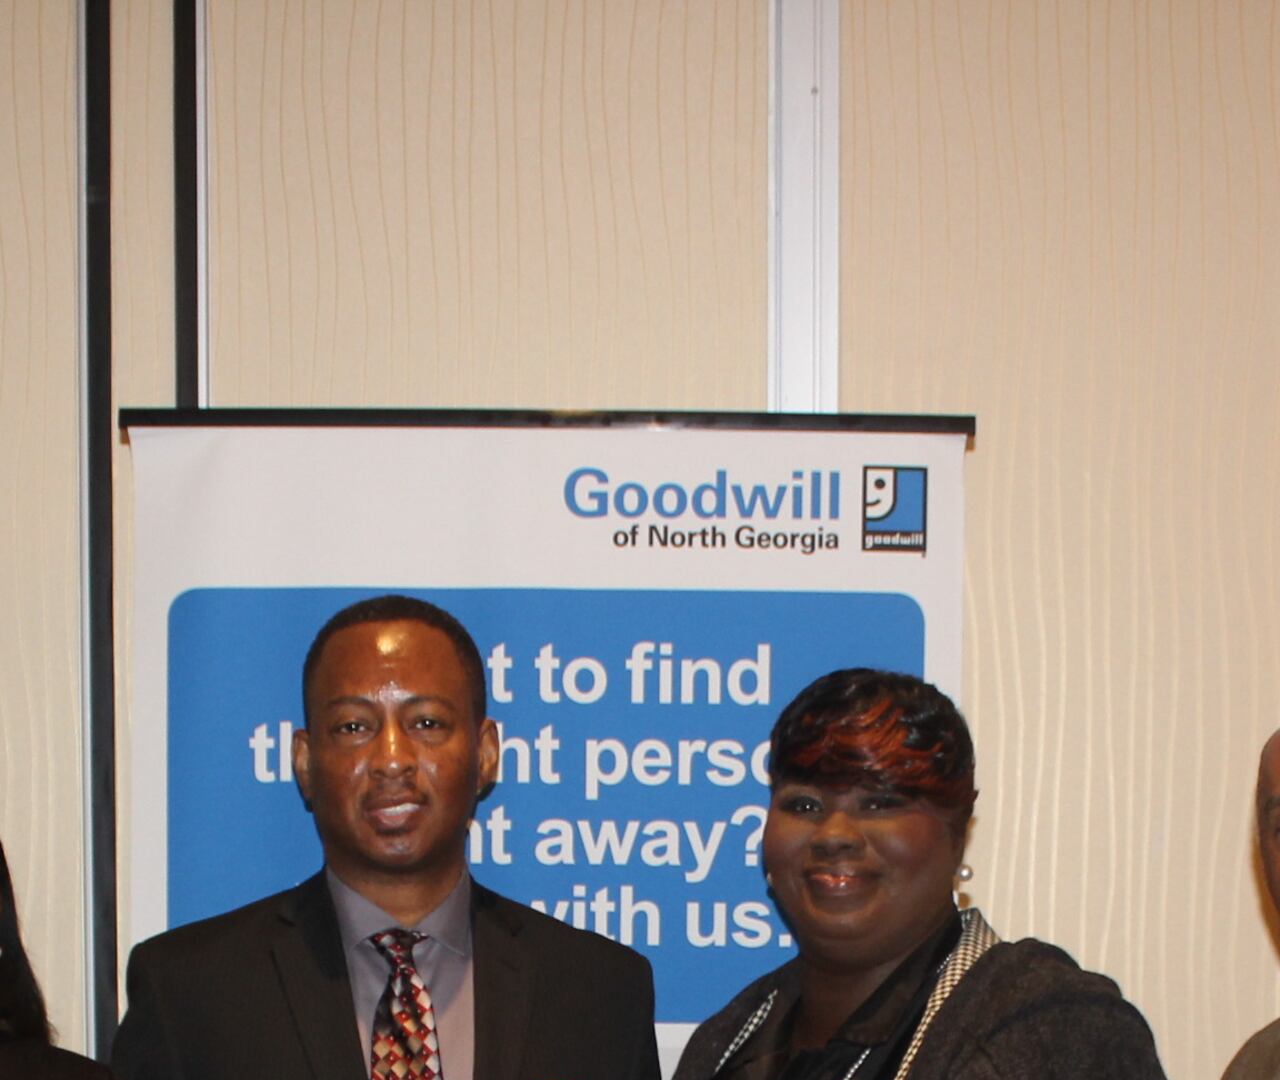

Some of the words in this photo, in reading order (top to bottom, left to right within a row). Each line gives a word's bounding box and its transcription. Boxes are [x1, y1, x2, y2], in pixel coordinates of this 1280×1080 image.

[563, 466, 840, 520] Goodwill
[612, 524, 639, 548] of
[648, 525, 726, 548] North
[734, 526, 839, 555] Georgia
[864, 532, 924, 549] goodwill
[534, 642, 608, 704] to
[625, 642, 772, 704] find
[585, 738, 772, 800] perso
[534, 805, 768, 883] away?
[685, 902, 792, 948] us.
